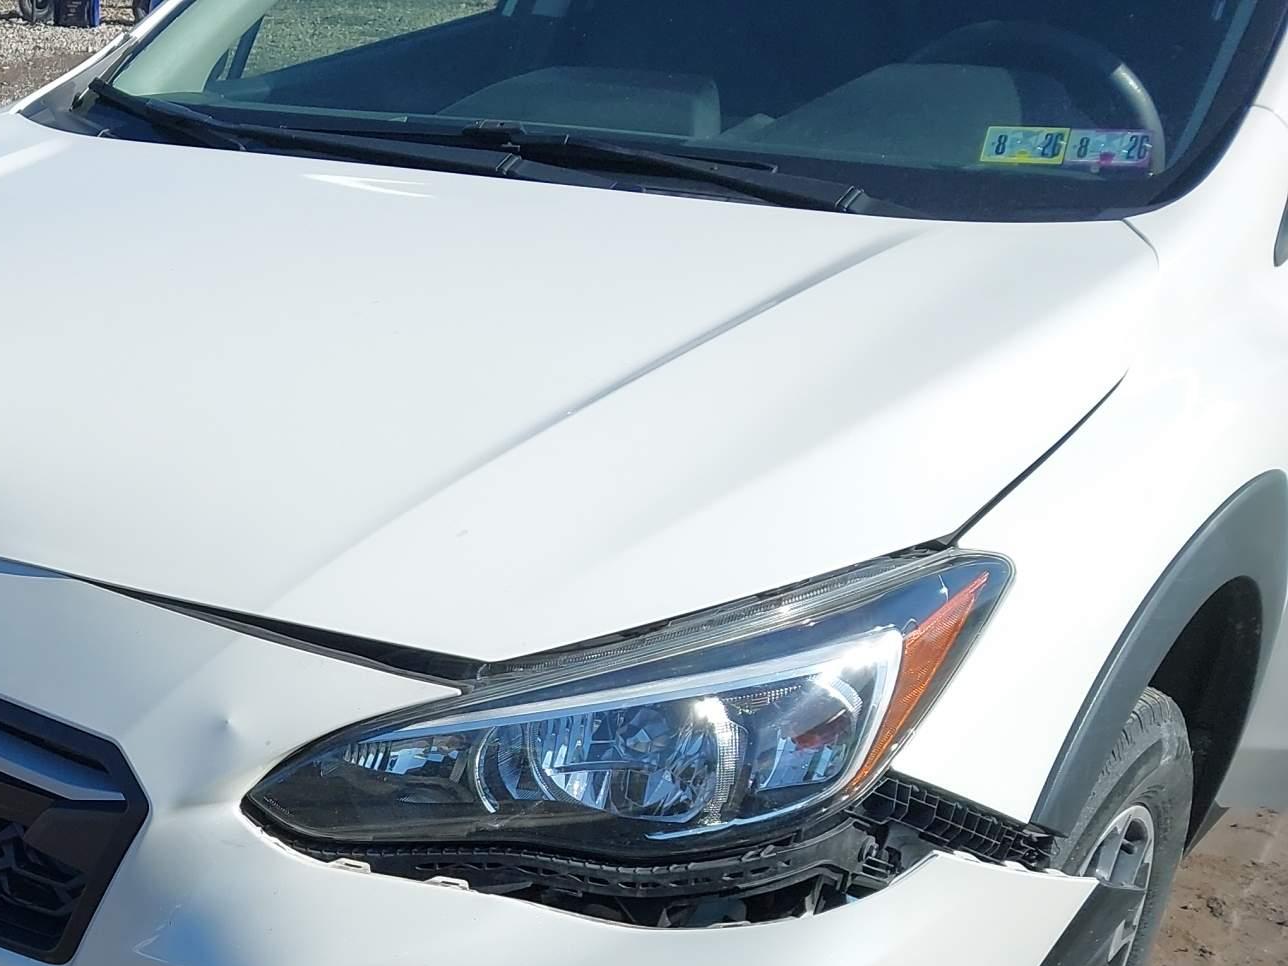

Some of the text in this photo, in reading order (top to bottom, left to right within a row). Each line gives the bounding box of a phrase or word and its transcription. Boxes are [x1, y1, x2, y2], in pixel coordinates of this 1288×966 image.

[994, 133, 1065, 158] 8 26
[1077, 135, 1150, 159] 8 26
